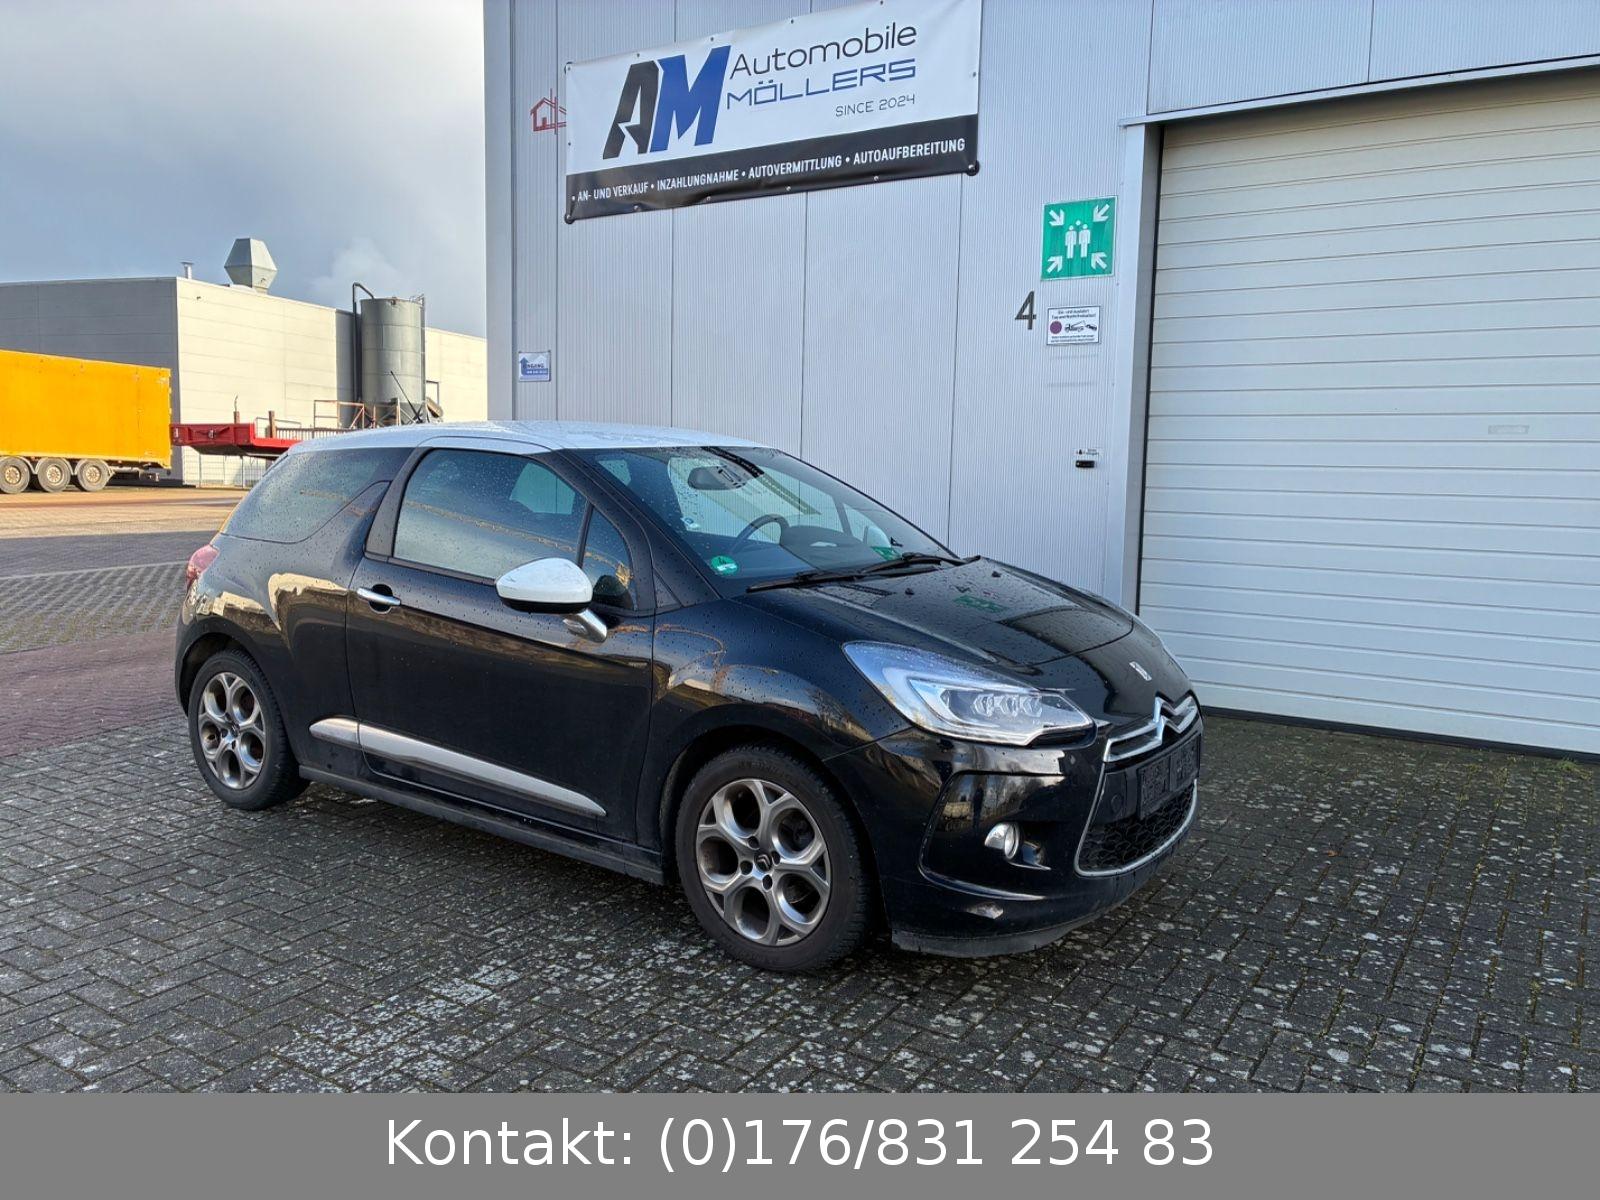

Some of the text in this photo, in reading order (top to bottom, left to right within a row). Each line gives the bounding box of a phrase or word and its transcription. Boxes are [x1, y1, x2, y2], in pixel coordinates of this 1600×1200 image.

[729, 22, 917, 80] Automobile
[602, 45, 732, 160] AM
[726, 58, 916, 110] MÖLLERS
[835, 93, 916, 117] SINCE 2024
[577, 138, 966, 202] AN- UND VERKAUF INZAHLUNGNAHME AUTOVERMITTLUNG AUTOAUFBEREITUNG
[1015, 290, 1037, 330] 4
